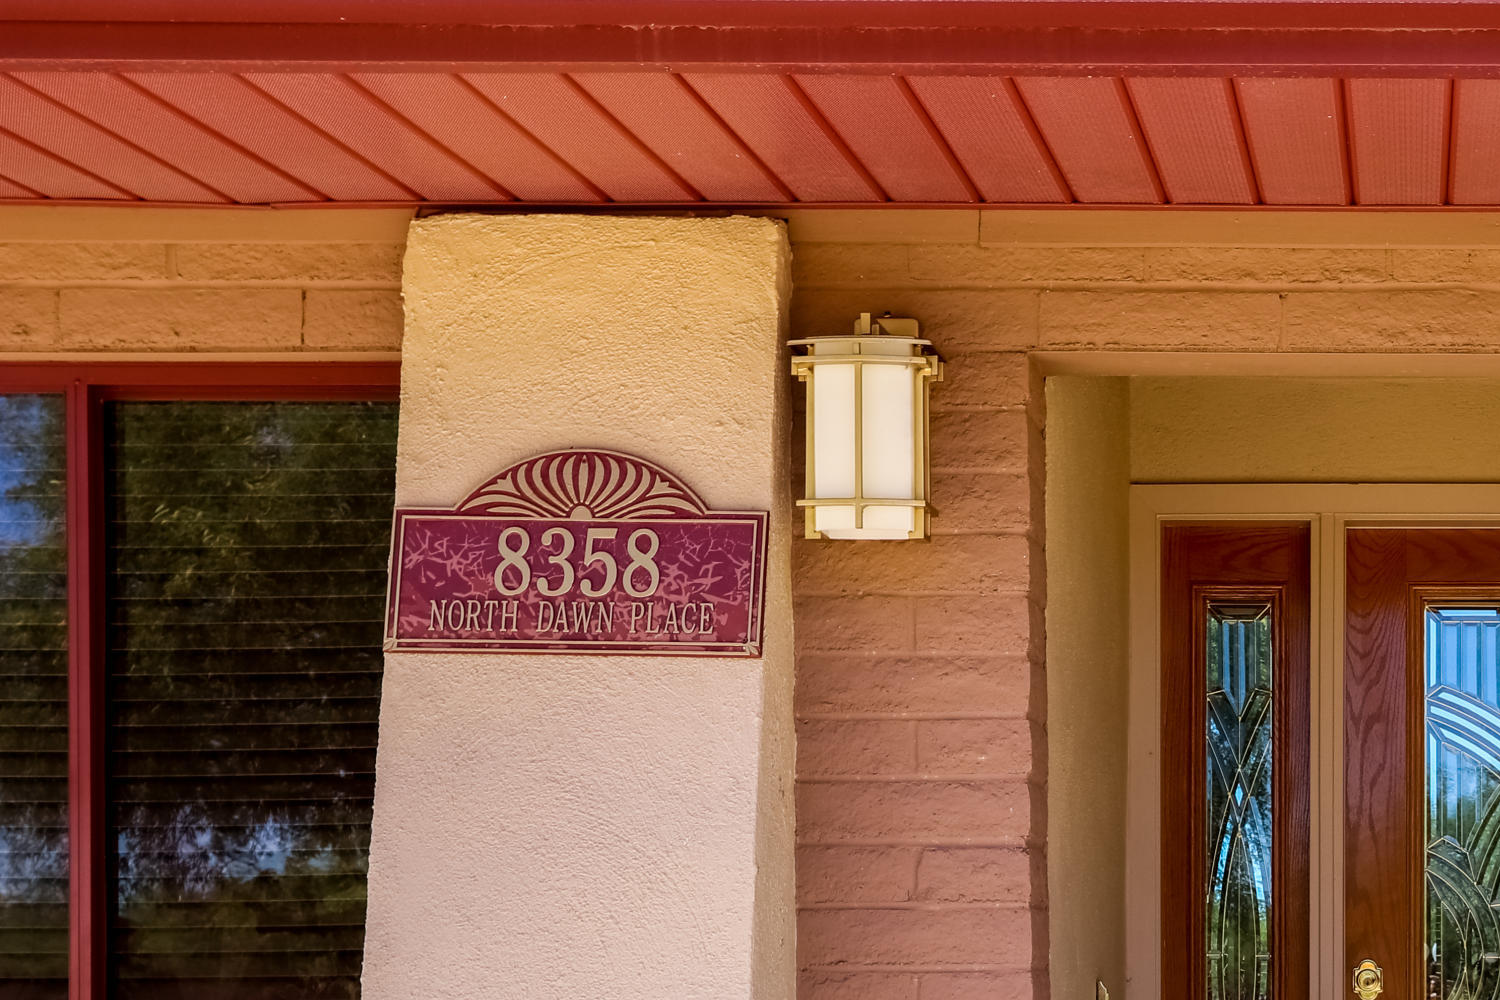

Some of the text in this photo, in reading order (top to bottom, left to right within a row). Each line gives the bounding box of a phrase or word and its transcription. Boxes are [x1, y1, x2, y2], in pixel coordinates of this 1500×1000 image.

[494, 526, 660, 598] 8358
[428, 599, 715, 635] NORTH DAWN PLACE
